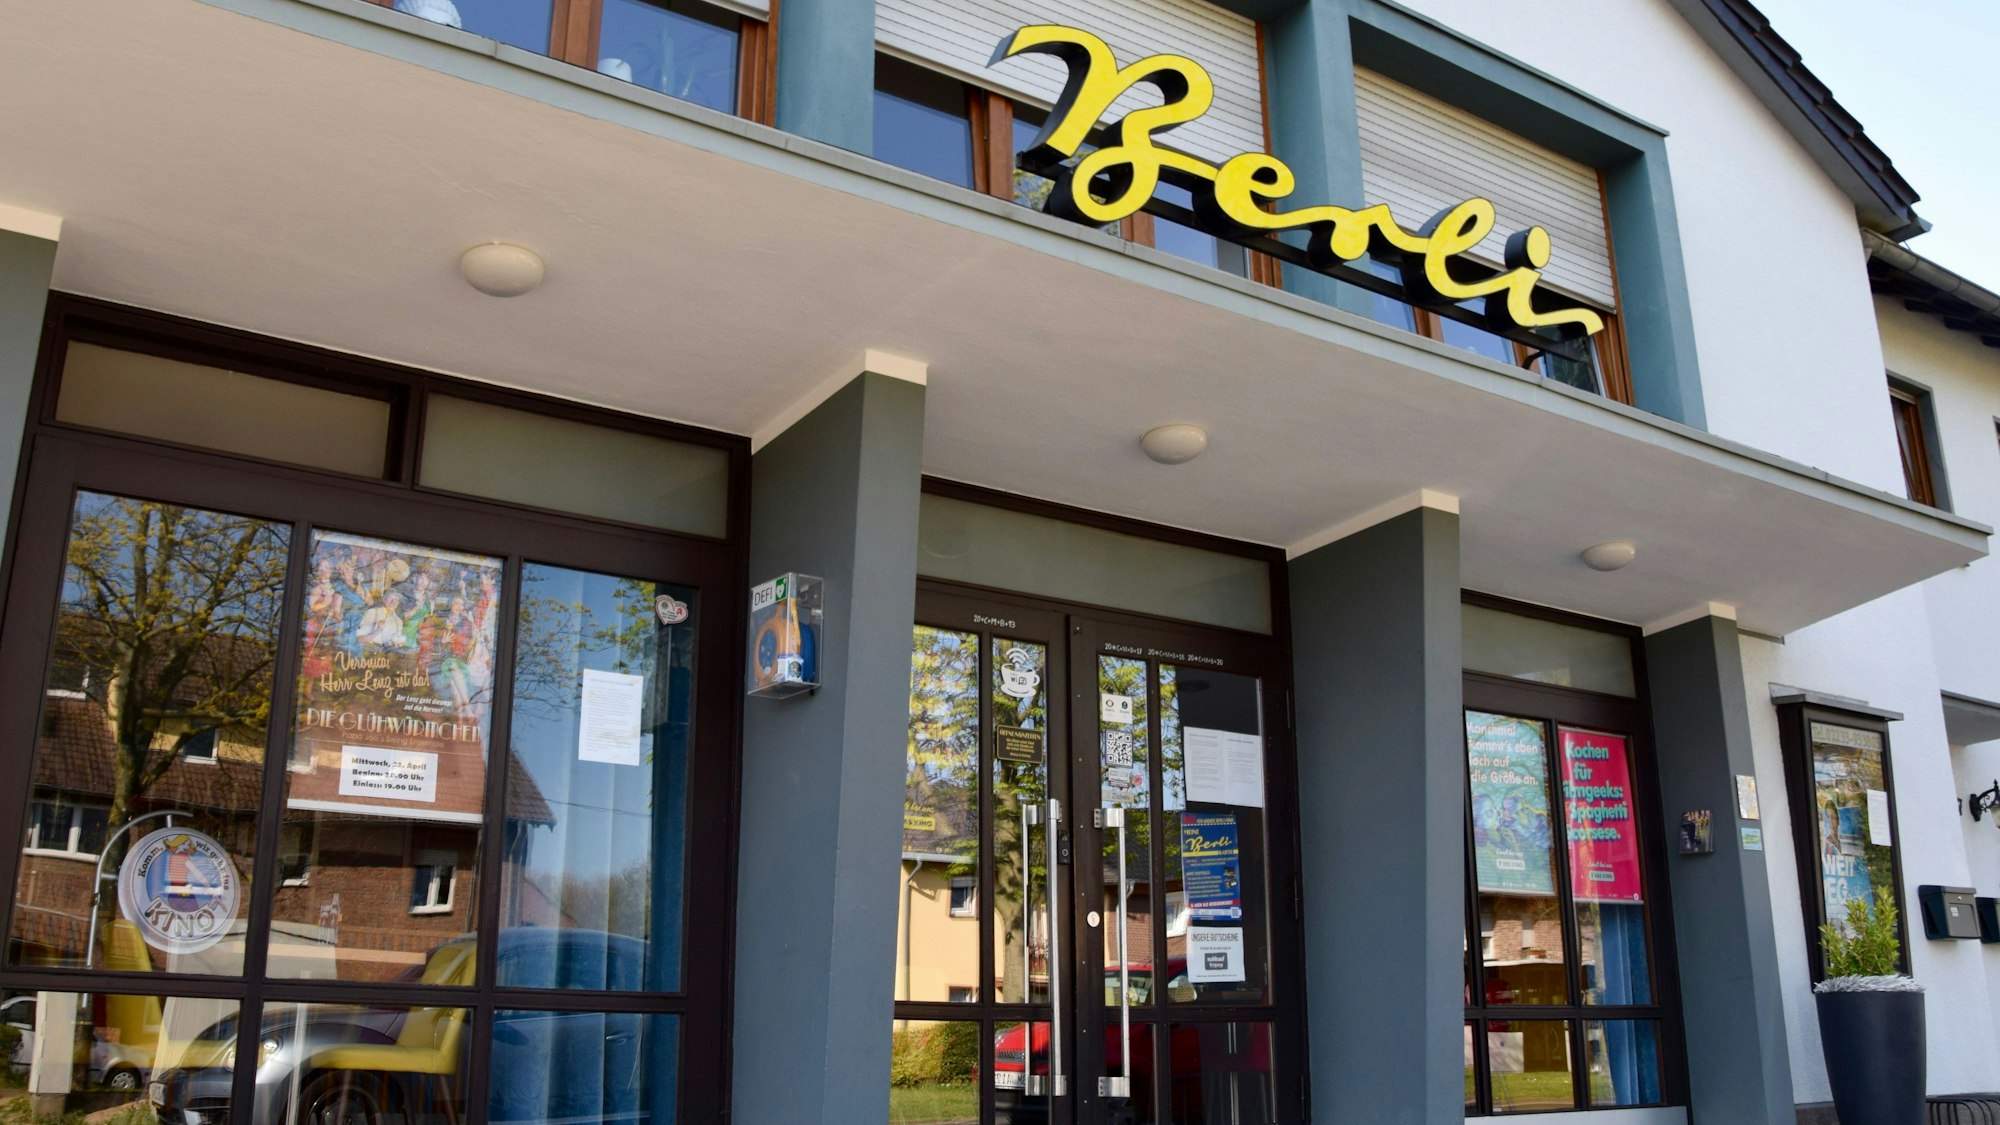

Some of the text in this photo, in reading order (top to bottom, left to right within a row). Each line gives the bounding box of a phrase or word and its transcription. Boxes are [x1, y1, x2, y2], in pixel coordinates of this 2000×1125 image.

[995, 24, 1605, 336] Berli
[754, 586, 773, 606] DEFI
[320, 668, 430, 699] Herr Lenz ist da!
[306, 707, 337, 729] DIE
[1515, 740, 1538, 754] eben
[1566, 741, 1609, 760] Kochen
[351, 757, 391, 768] Mittwoch,
[407, 762, 427, 770] April
[1493, 755, 1510, 767] auf
[1471, 769, 1539, 785] die Größe an.
[1574, 762, 1593, 780] für
[384, 783, 406, 791] 19.00
[1563, 780, 1624, 804] ilmgeeks:
[1570, 800, 1629, 825] Spaghetti
[195, 840, 211, 857] wir
[1185, 836, 1232, 854] Berli
[1822, 854, 1856, 877] WEIT
[144, 897, 217, 938] KINO
[1191, 933, 1239, 942] UNSERE GUTSCHEINE
